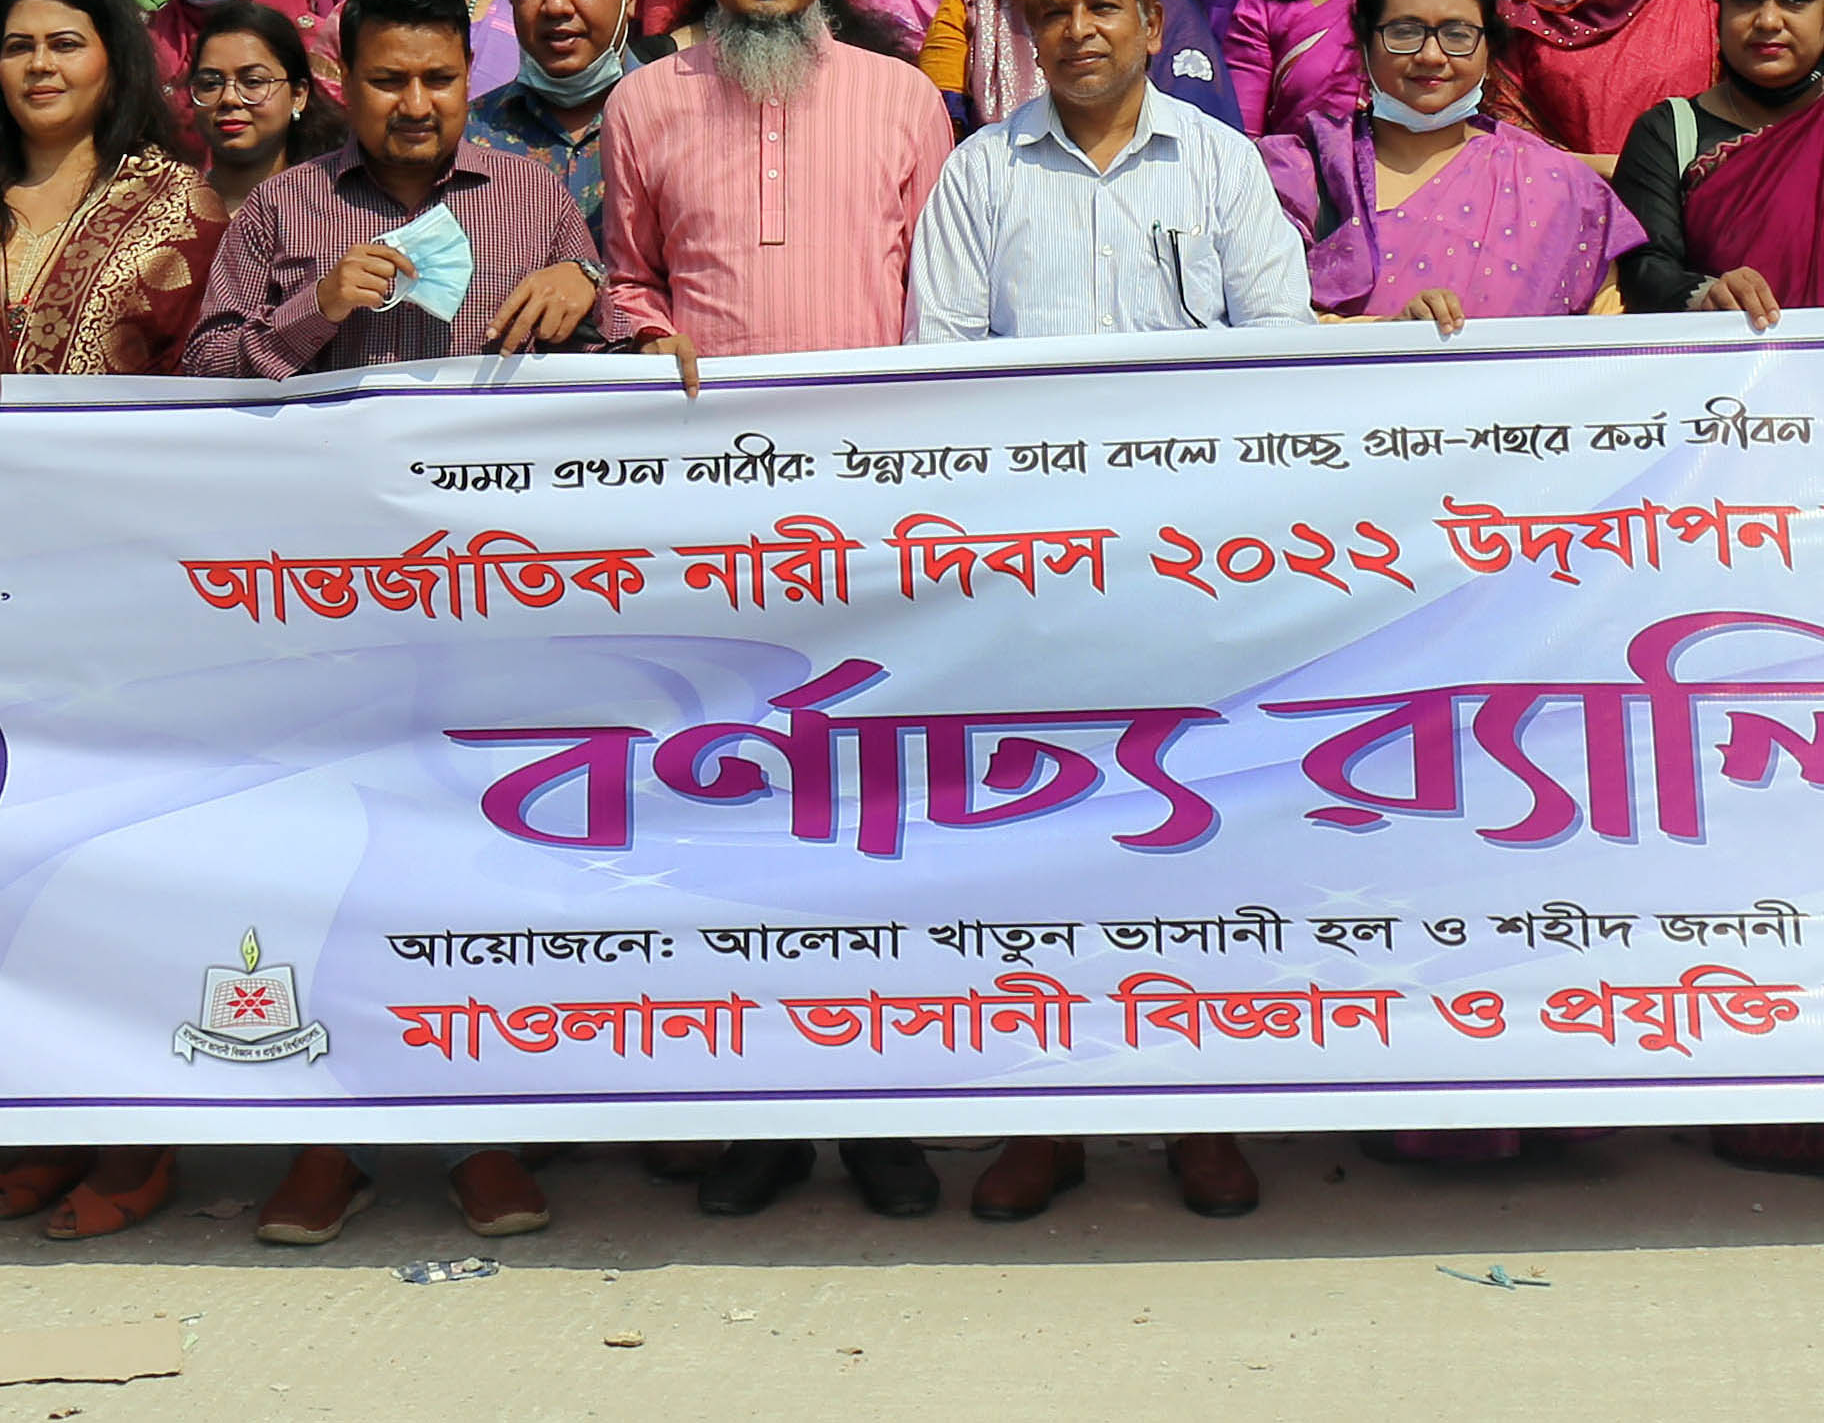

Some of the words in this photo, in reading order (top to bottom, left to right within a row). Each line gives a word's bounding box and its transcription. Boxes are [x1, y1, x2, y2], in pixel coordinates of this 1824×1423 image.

[552, 457, 669, 488] এখন
[832, 438, 992, 485] উন্নয়নে
[1004, 440, 1088, 477] তারা
[1102, 437, 1221, 473] বদলে
[1233, 432, 1351, 470] যাচ্ছে
[1584, 412, 1671, 451] কর্ম
[1678, 395, 1816, 450] জীবন
[180, 525, 653, 625] আন্তর্জাতিক
[671, 512, 867, 613] নারী
[883, 510, 1118, 601] দিবস
[1148, 517, 1418, 597] ২০২২
[443, 657, 1225, 861] বর্ণাঢ্য
[700, 919, 906, 964] আলেমা
[927, 919, 1082, 965] খাতুন
[1099, 903, 1290, 955] ভাসানী
[1309, 913, 1394, 954] হল
[1424, 915, 1469, 948] ও
[1496, 901, 1636, 951] শহীদ
[1654, 899, 1806, 948] জননী
[390, 988, 762, 1063] মাওলানা
[782, 969, 1092, 1054] ভাসানী
[1110, 969, 1406, 1051] বিজ্ঞান
[1434, 988, 1509, 1040] ও
[1540, 963, 1806, 1057] প্রযুক্তি
